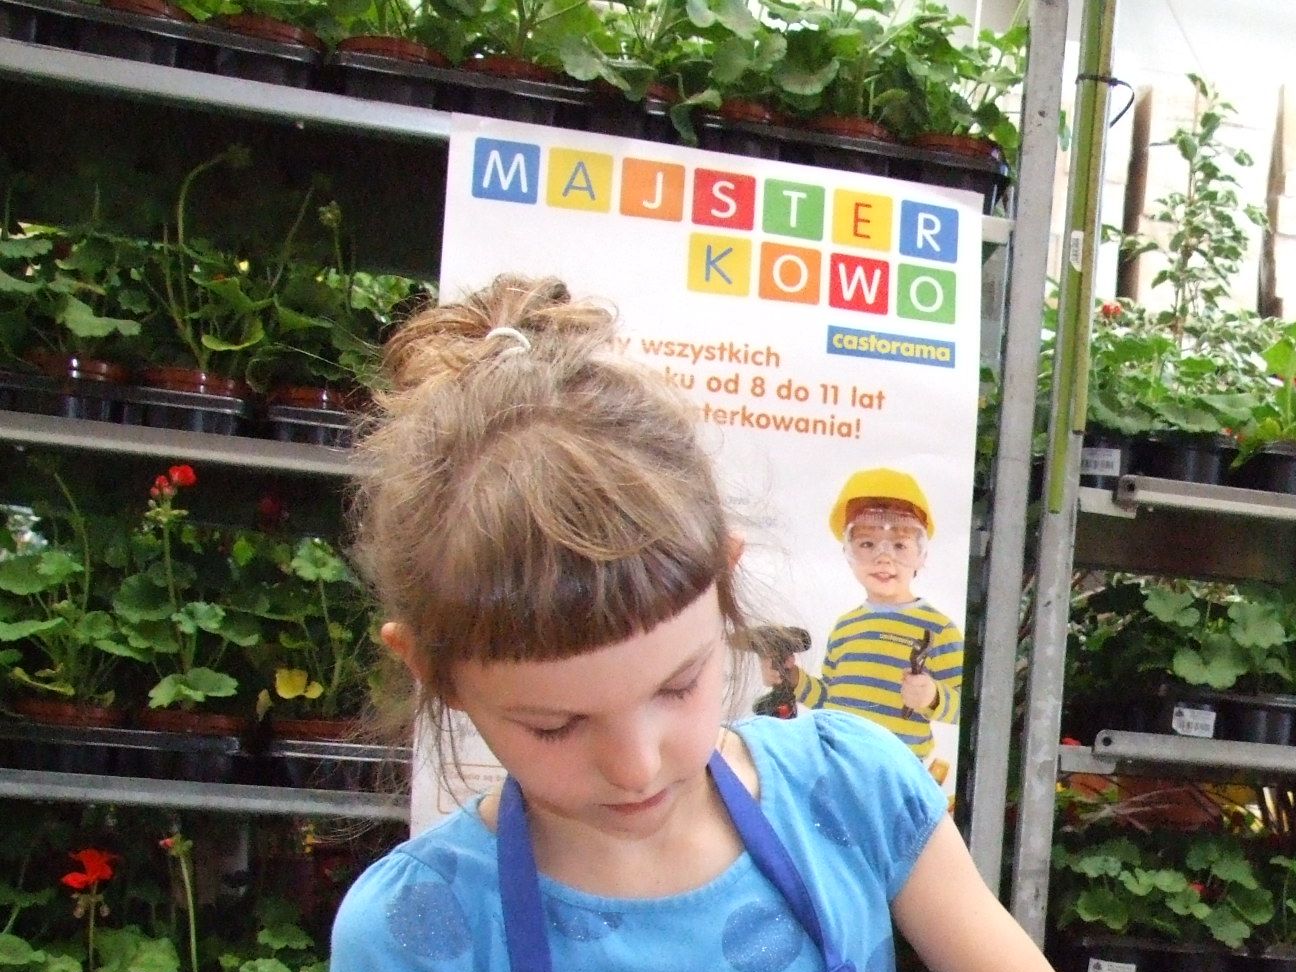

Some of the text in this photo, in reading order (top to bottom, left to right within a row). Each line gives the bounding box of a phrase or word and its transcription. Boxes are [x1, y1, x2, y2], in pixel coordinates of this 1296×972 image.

[480, 148, 942, 254] MAJSTER
[702, 244, 944, 315] KOWO
[641, 338, 780, 369] wszystkich
[832, 331, 951, 362] castorama
[706, 373, 740, 395] od
[750, 376, 766, 398] 8
[776, 376, 810, 401] do
[820, 383, 840, 405] 11
[850, 386, 885, 411] lat
[702, 403, 861, 439] terkowania!
